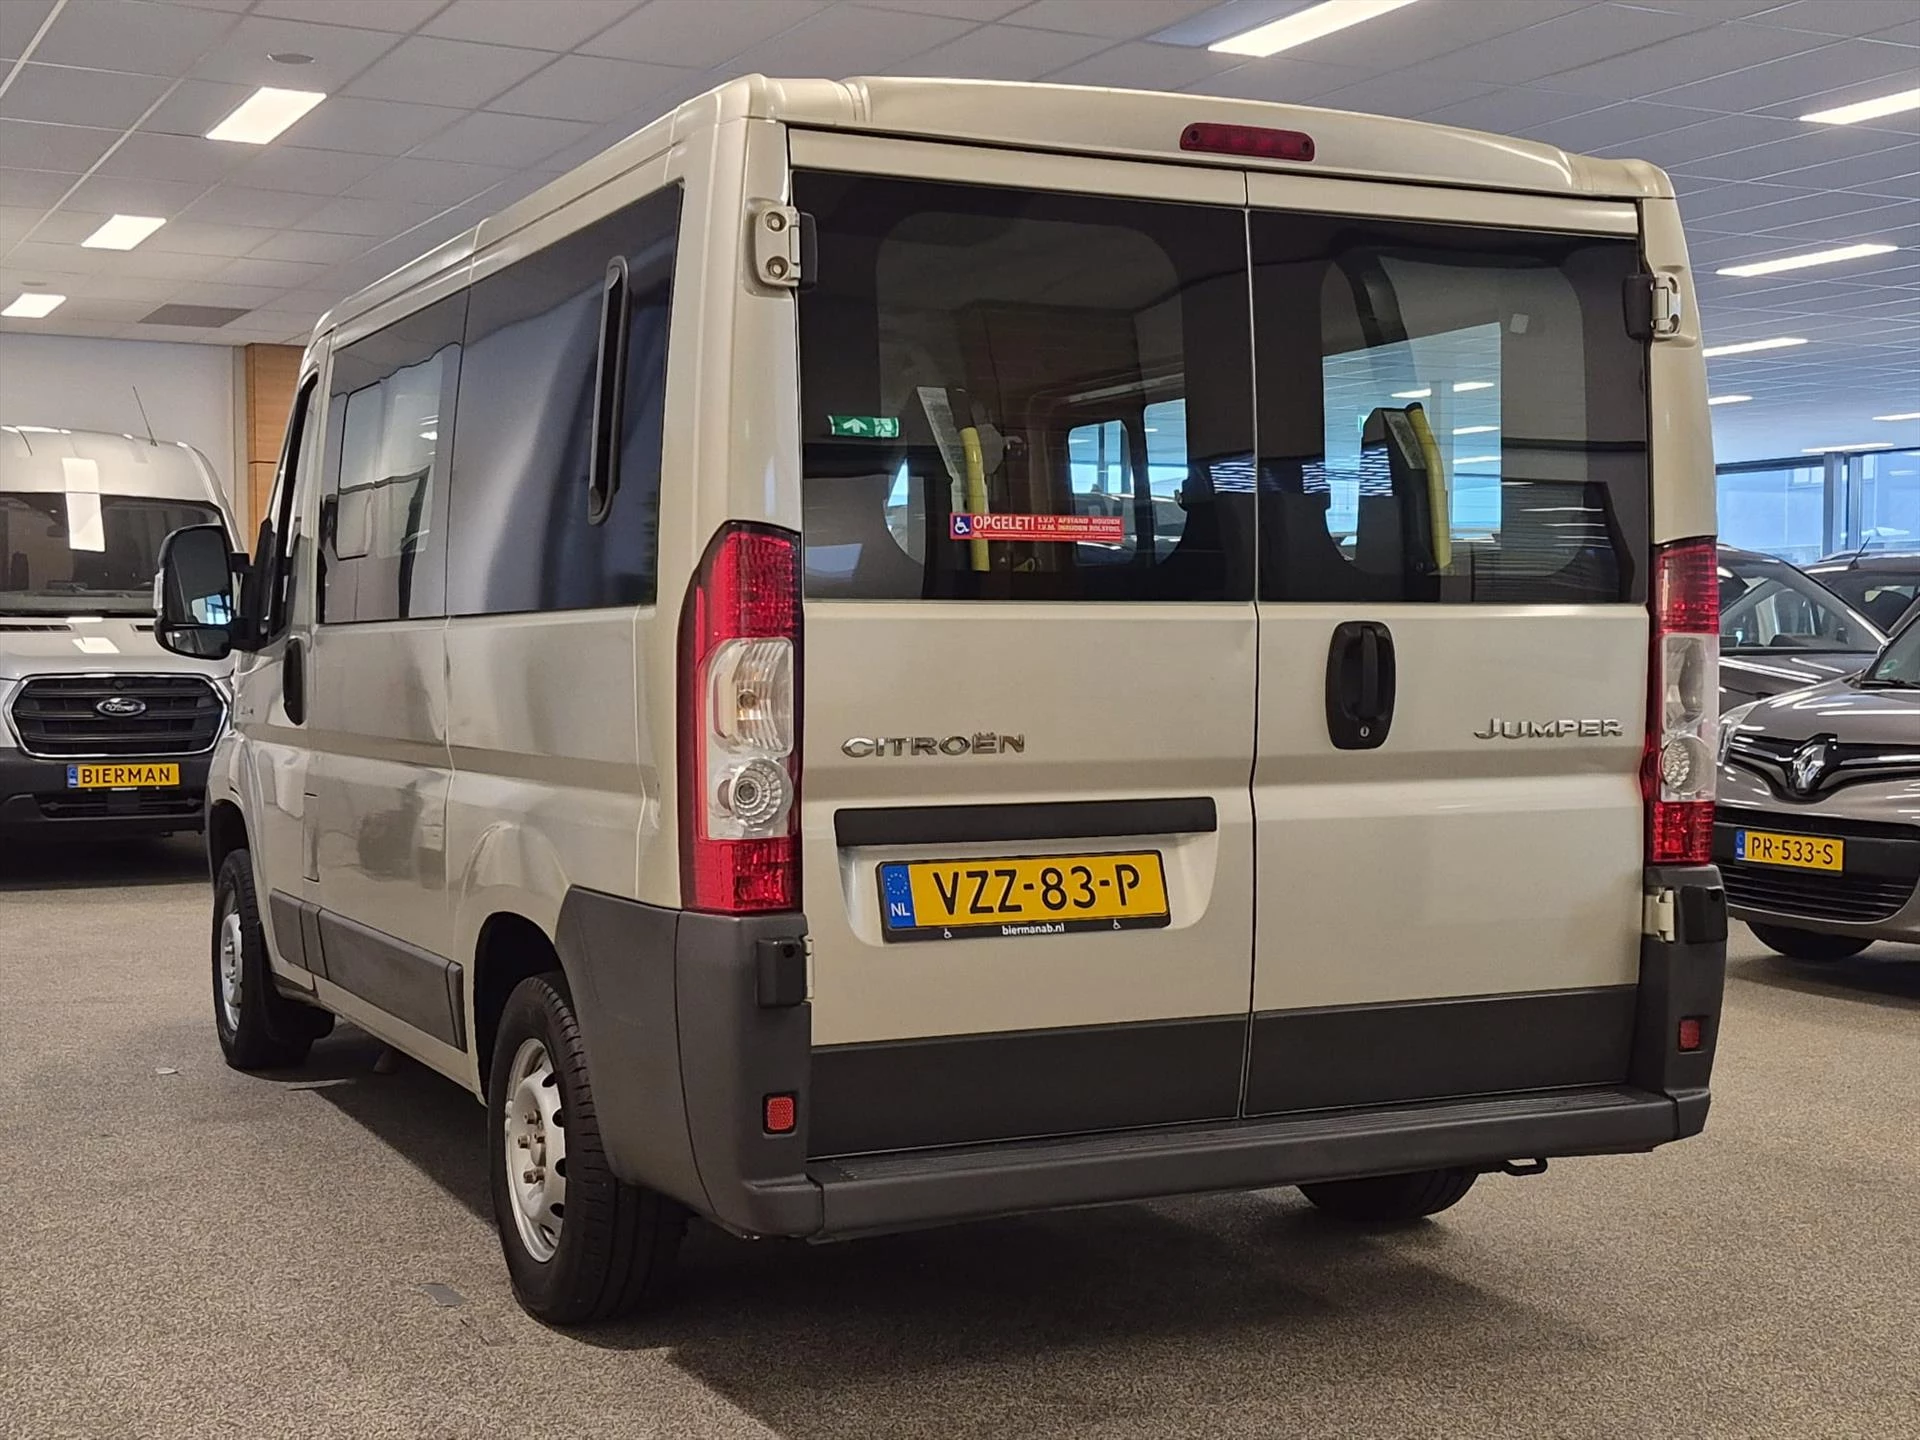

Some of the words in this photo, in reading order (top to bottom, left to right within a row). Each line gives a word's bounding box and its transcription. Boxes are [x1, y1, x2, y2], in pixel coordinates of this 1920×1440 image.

[973, 515, 1034, 531] OPGELET!
[1058, 517, 1089, 525] AFSTAND
[1473, 717, 1624, 739] JUMPER
[840, 731, 1025, 758] CITROËN
[81, 767, 171, 784] BIERMAN
[1751, 836, 1834, 865] PR-533-S
[890, 902, 911, 917] NL
[932, 863, 1141, 916] VZZ-83-P
[1001, 922, 1065, 936] biermanab.nl
